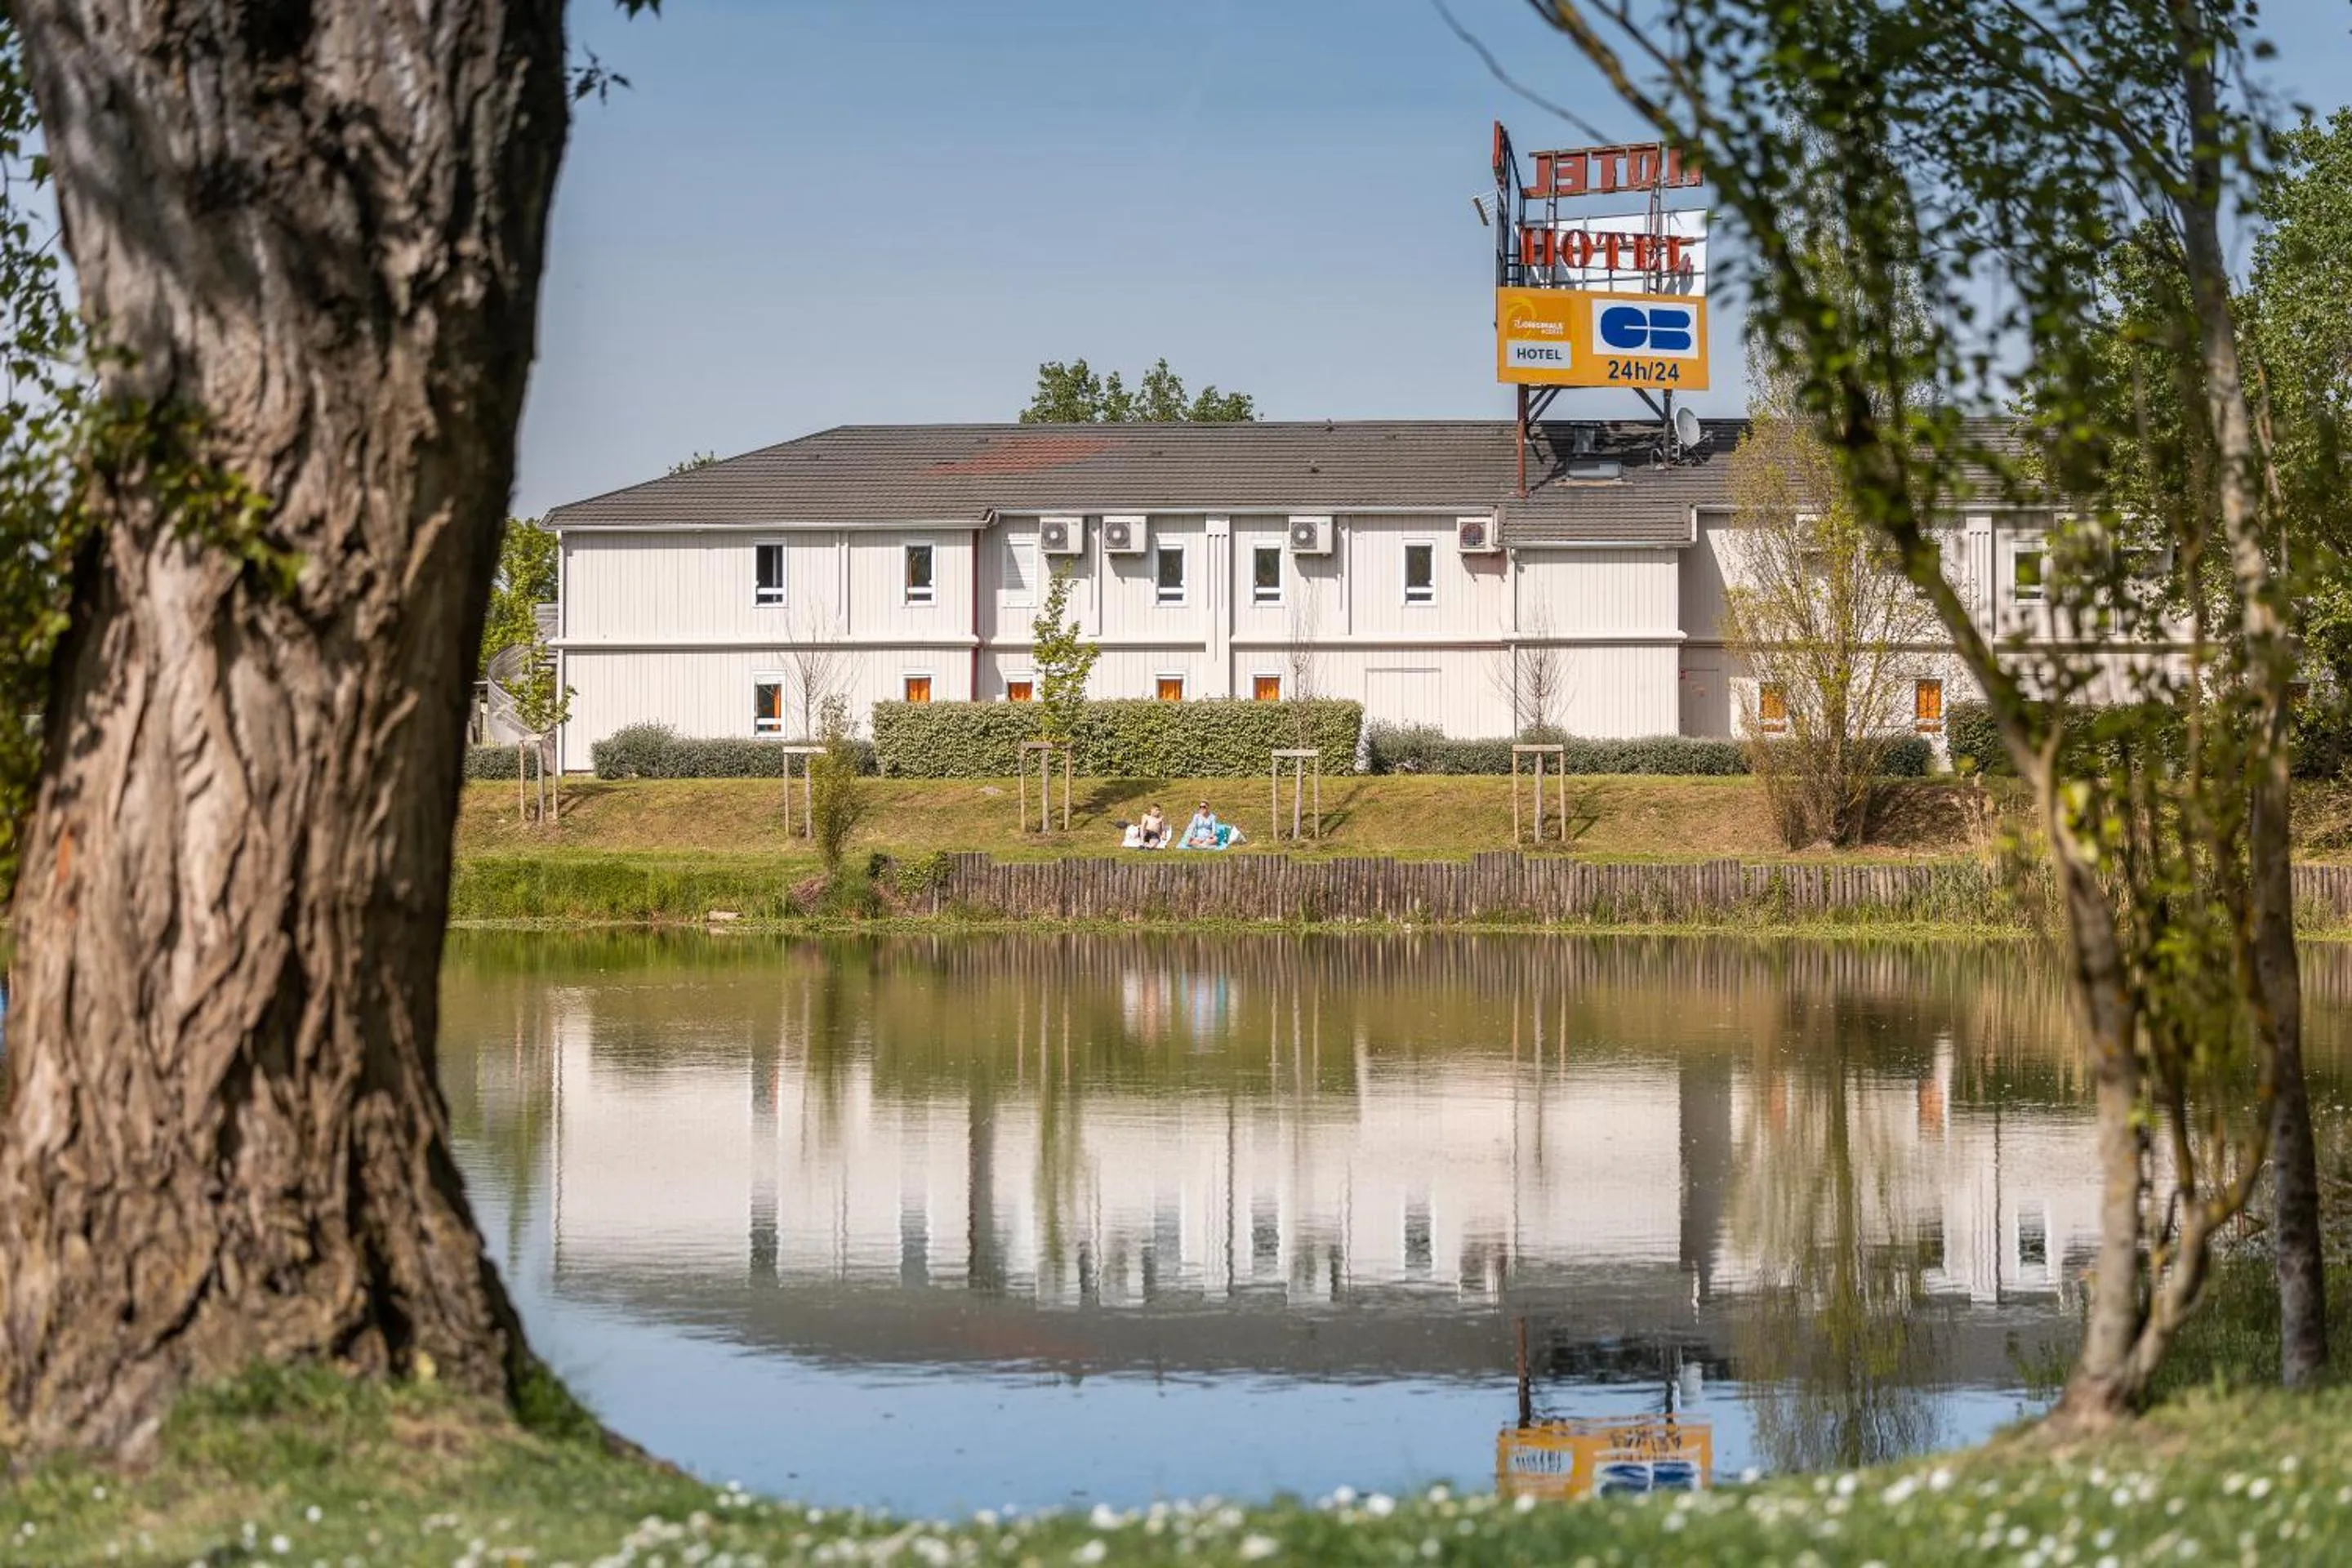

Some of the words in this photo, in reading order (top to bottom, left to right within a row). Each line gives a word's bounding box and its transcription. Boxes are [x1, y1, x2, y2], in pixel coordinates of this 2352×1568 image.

[1519, 229, 1693, 274] HOTEL
[1601, 306, 1691, 350] CB
[1517, 348, 1562, 360] HOTEL
[1608, 360, 1680, 381] 24h/24
